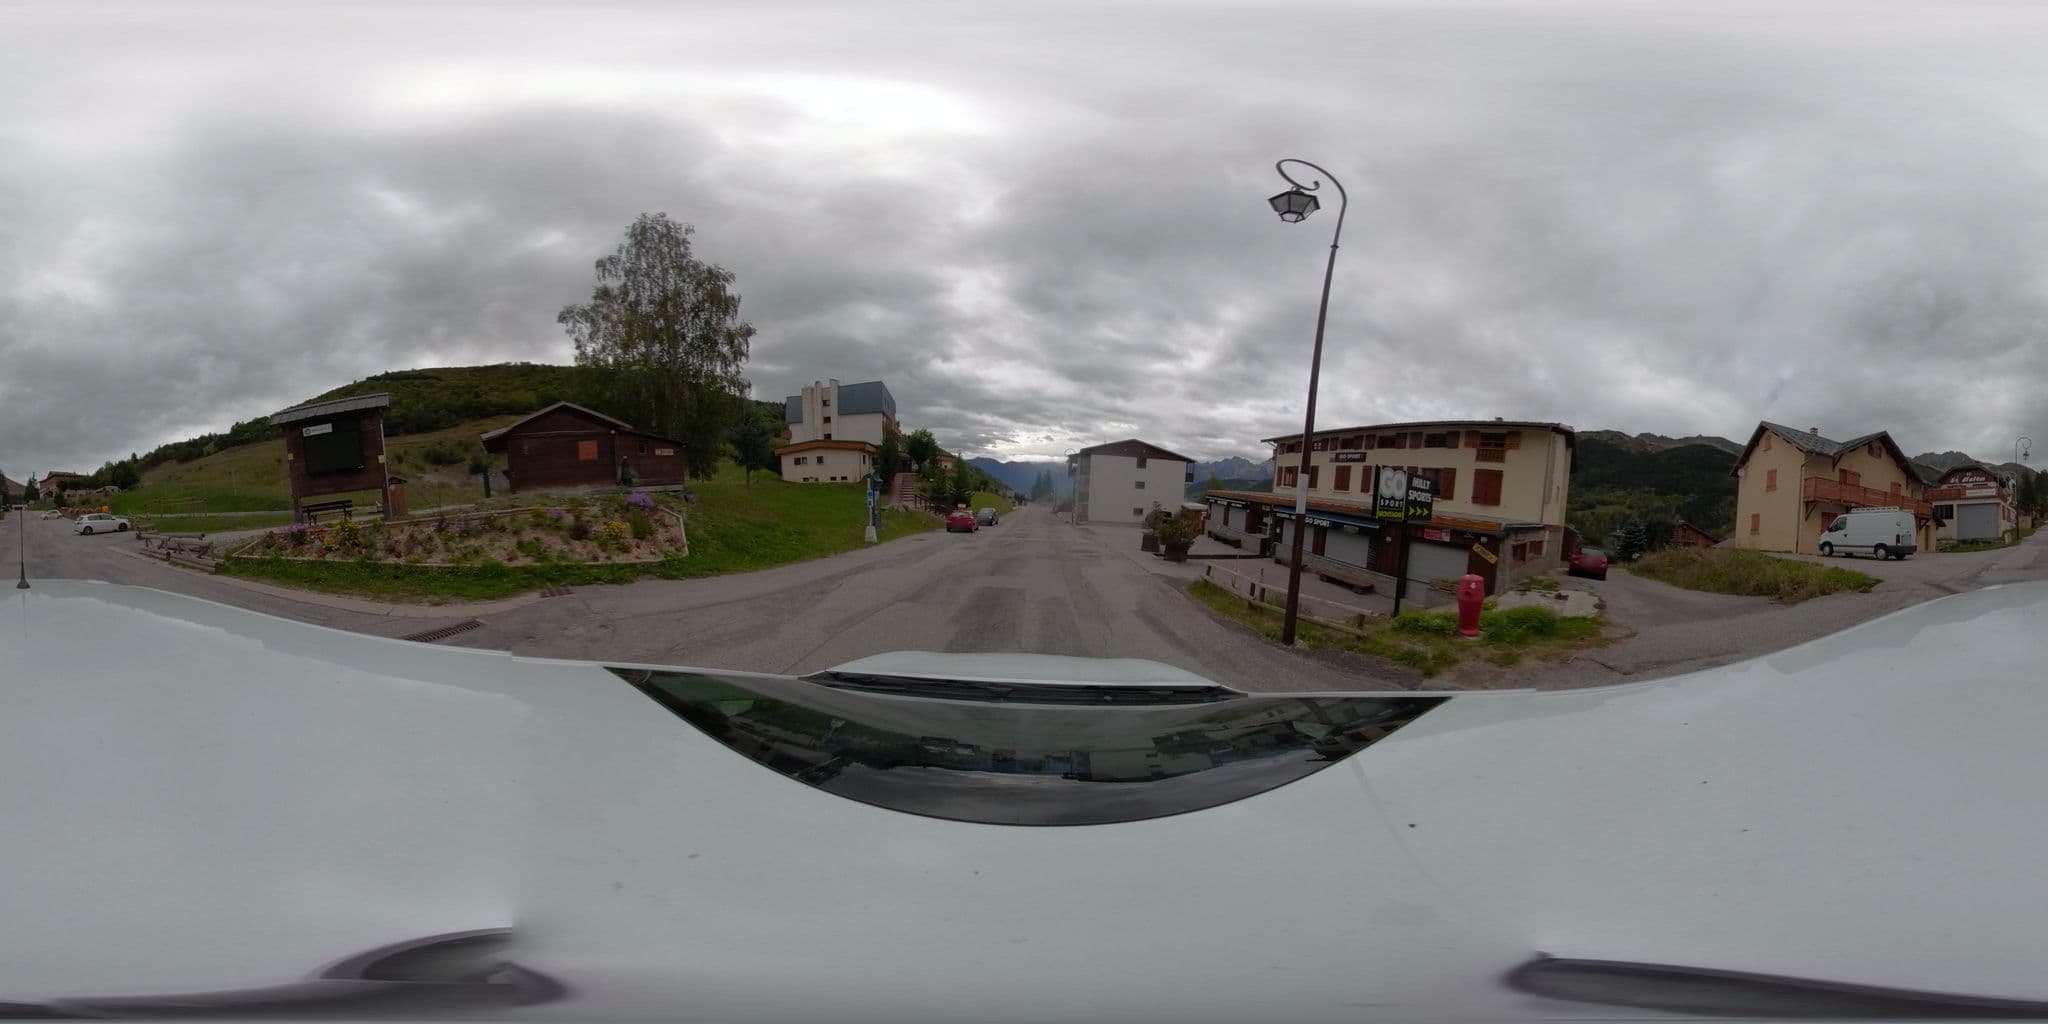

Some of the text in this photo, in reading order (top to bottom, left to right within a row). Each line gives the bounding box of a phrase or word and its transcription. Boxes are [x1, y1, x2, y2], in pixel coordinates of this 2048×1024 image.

[1380, 467, 1405, 500] GO
[1412, 477, 1431, 490] MILLY
[1408, 490, 1432, 503] SPORTS
[1380, 499, 1404, 508] SPORT
[1313, 519, 1330, 527] SPORT
